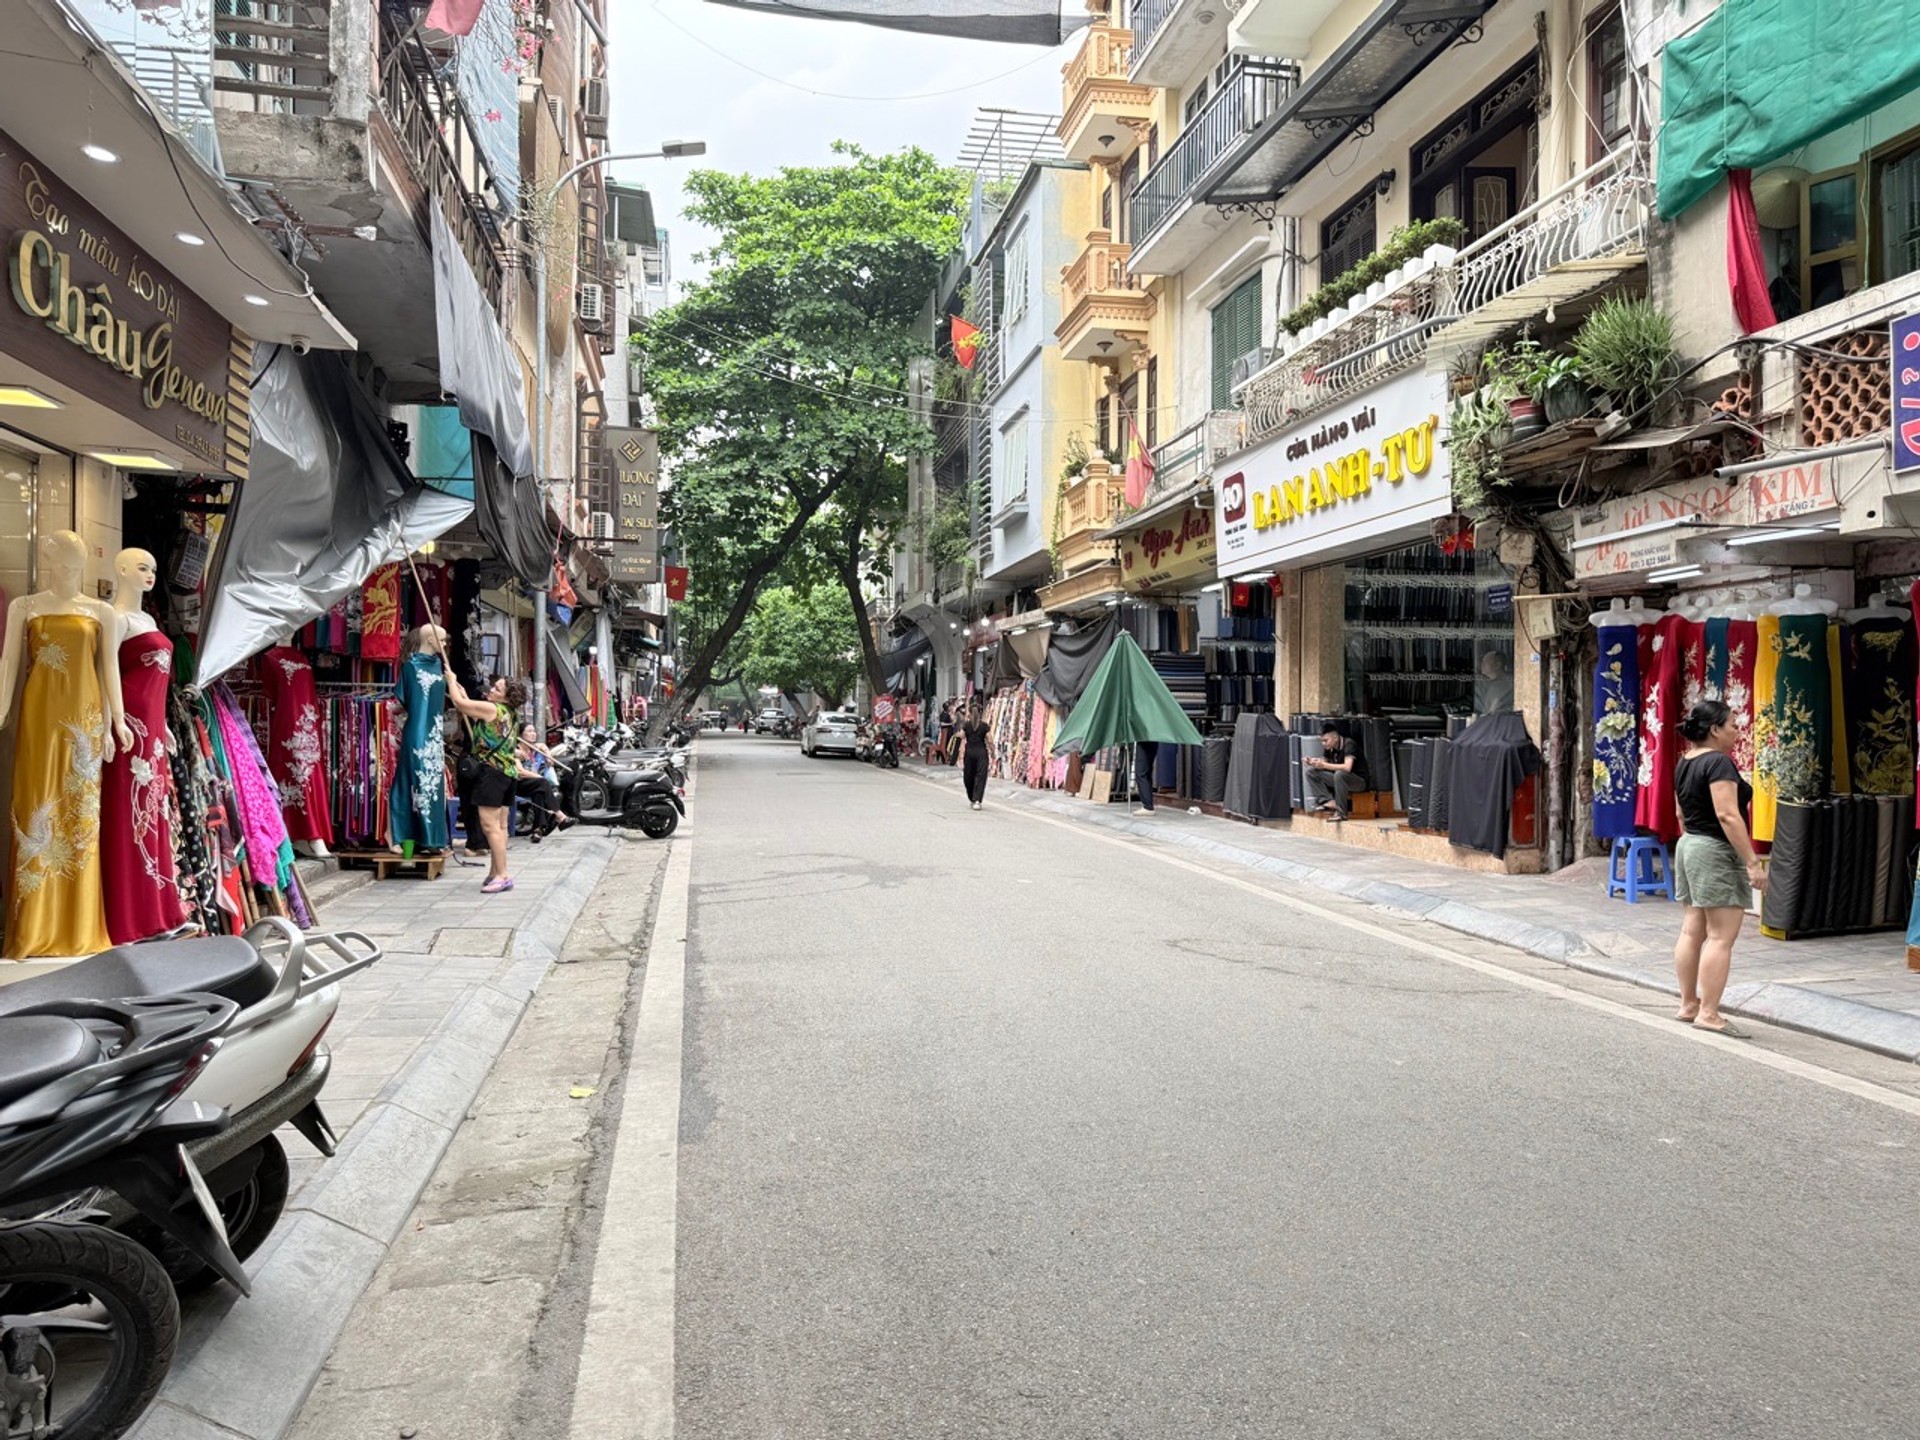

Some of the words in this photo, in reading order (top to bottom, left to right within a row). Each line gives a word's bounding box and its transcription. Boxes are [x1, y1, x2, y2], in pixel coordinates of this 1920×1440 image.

[19, 161, 68, 236] Tạo
[79, 228, 119, 276] mẫu
[127, 254, 154, 301] ÁO
[157, 284, 180, 323] DÀI
[12, 229, 143, 379] Châu
[1286, 436, 1309, 462] CỬA
[1311, 425, 1349, 452] HÀNG
[1351, 405, 1376, 433] VẢI
[1252, 475, 1304, 530] LAN
[1750, 462, 1823, 509] KIM
[1613, 551, 1628, 570] 42
